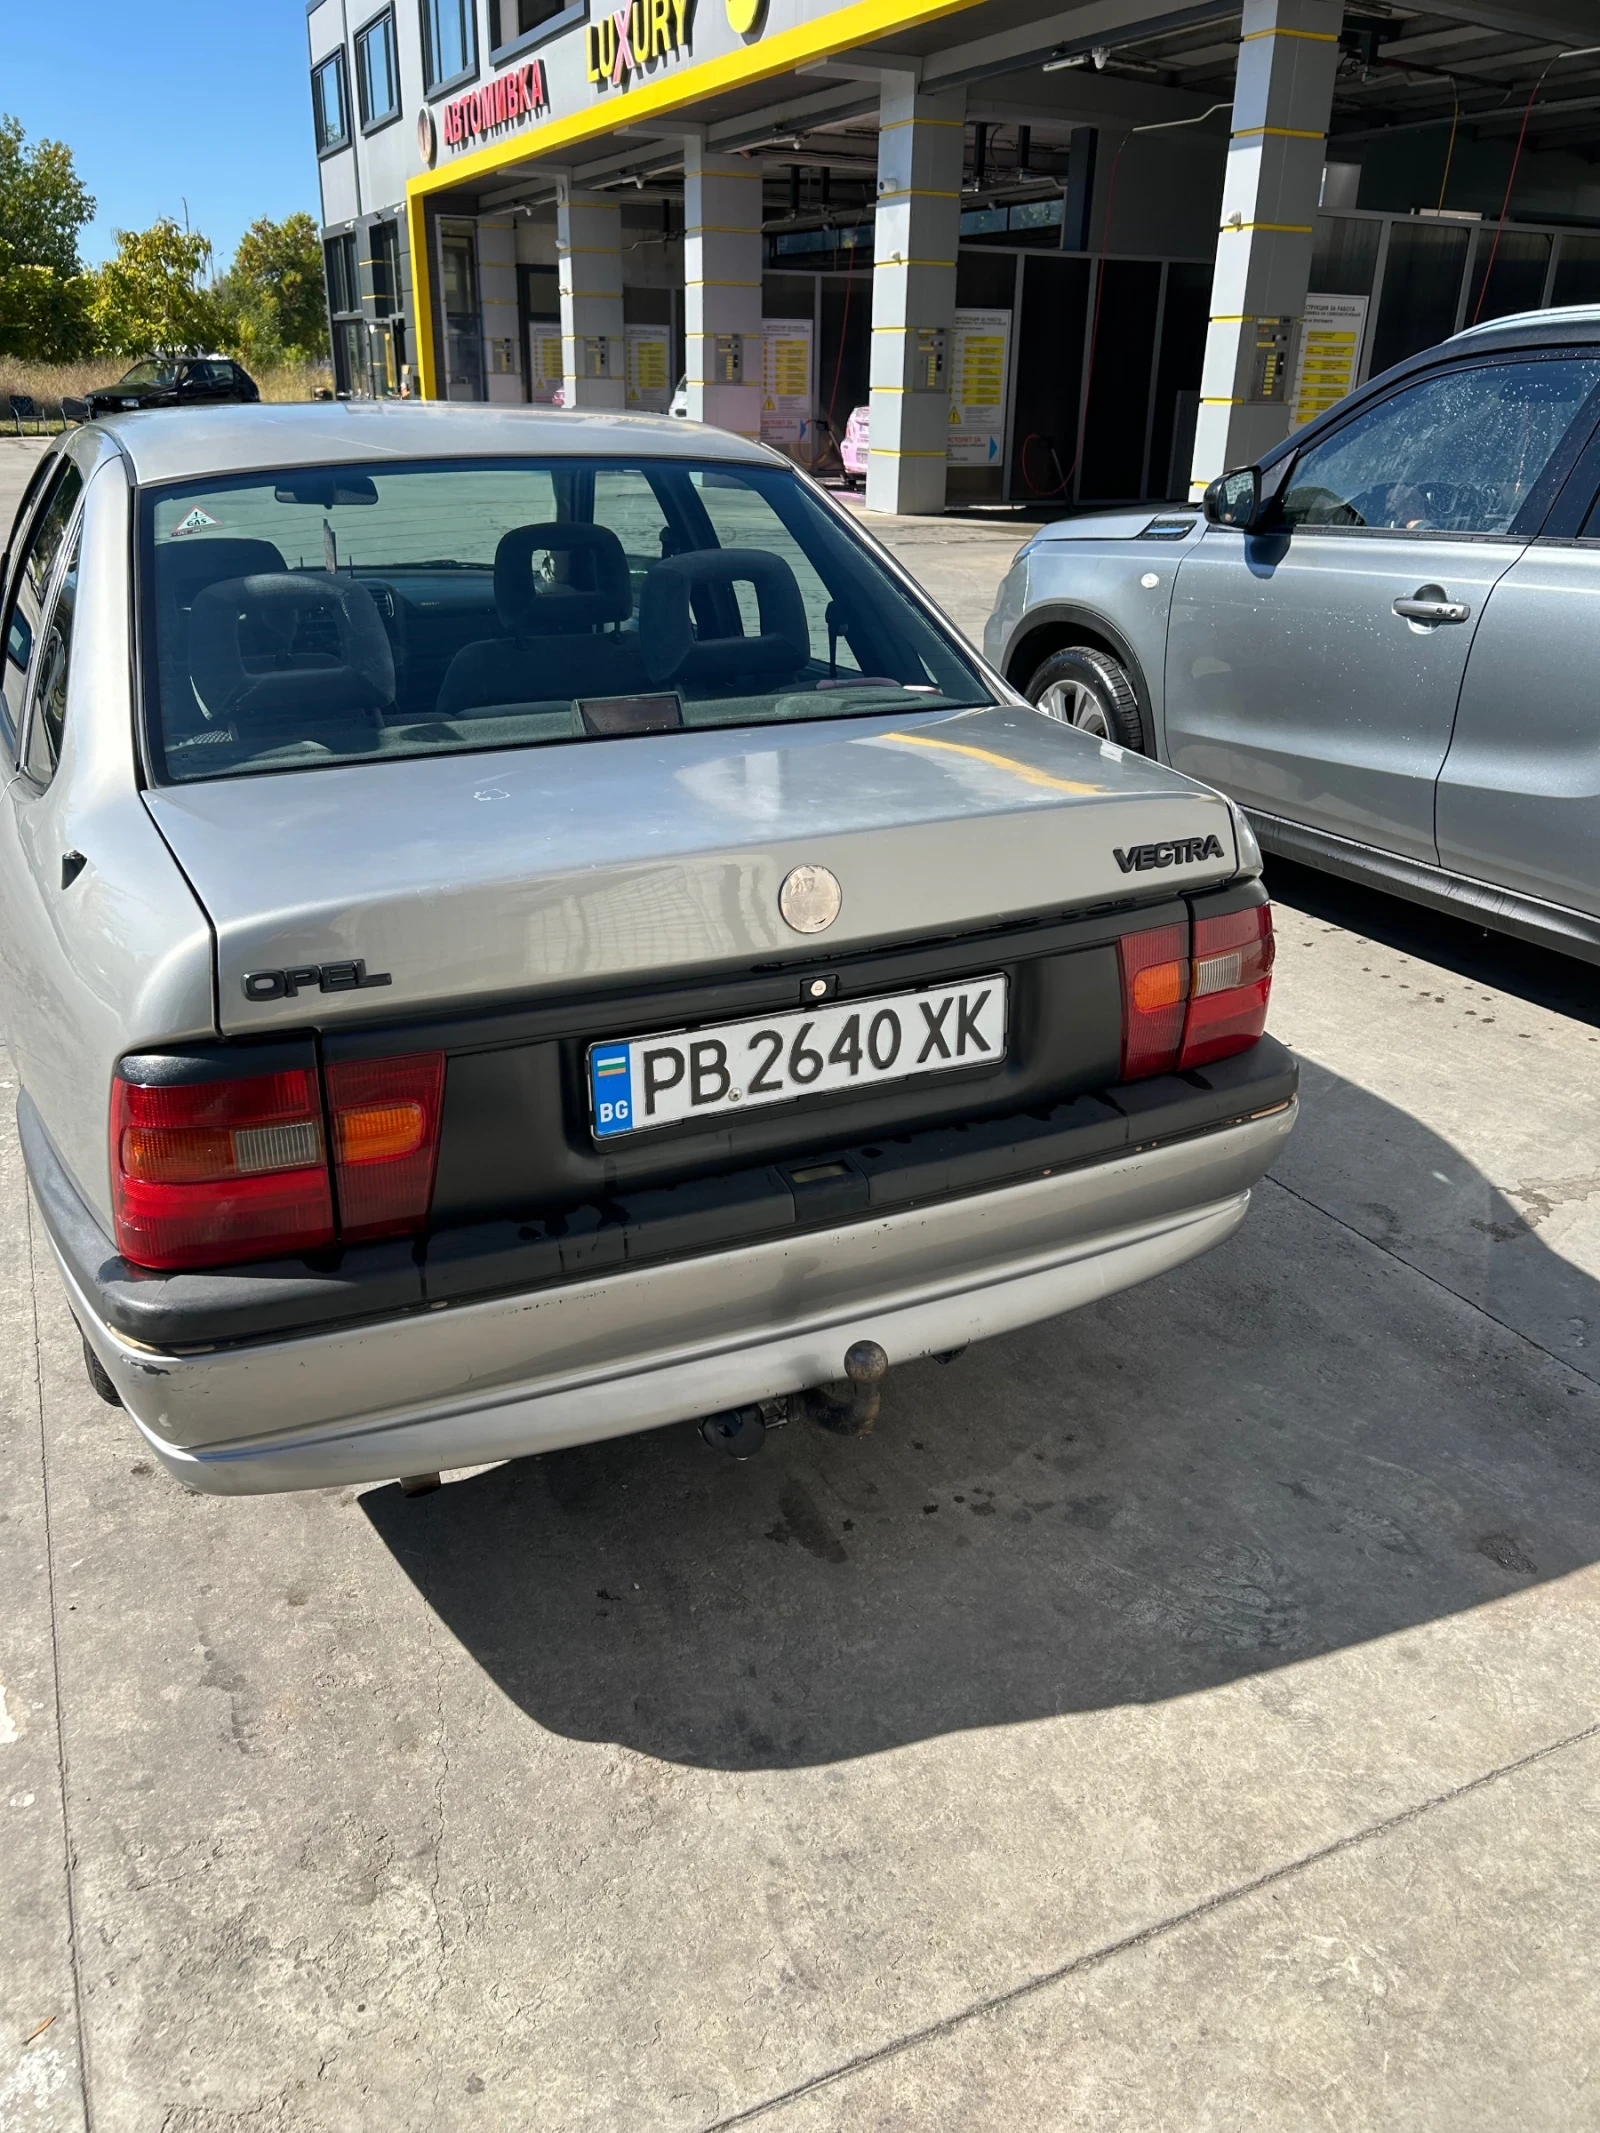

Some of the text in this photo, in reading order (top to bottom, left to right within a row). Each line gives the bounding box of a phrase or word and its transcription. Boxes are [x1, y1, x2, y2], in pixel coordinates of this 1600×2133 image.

[586, 0, 687, 85] LUXURY
[444, 59, 544, 146] АВТОМИВКА
[187, 518, 207, 526] GAS
[1113, 834, 1225, 873] VECTRA
[240, 958, 392, 1002] OPEL
[643, 989, 992, 1116] PB 2640 XK
[600, 1100, 629, 1123] BG
